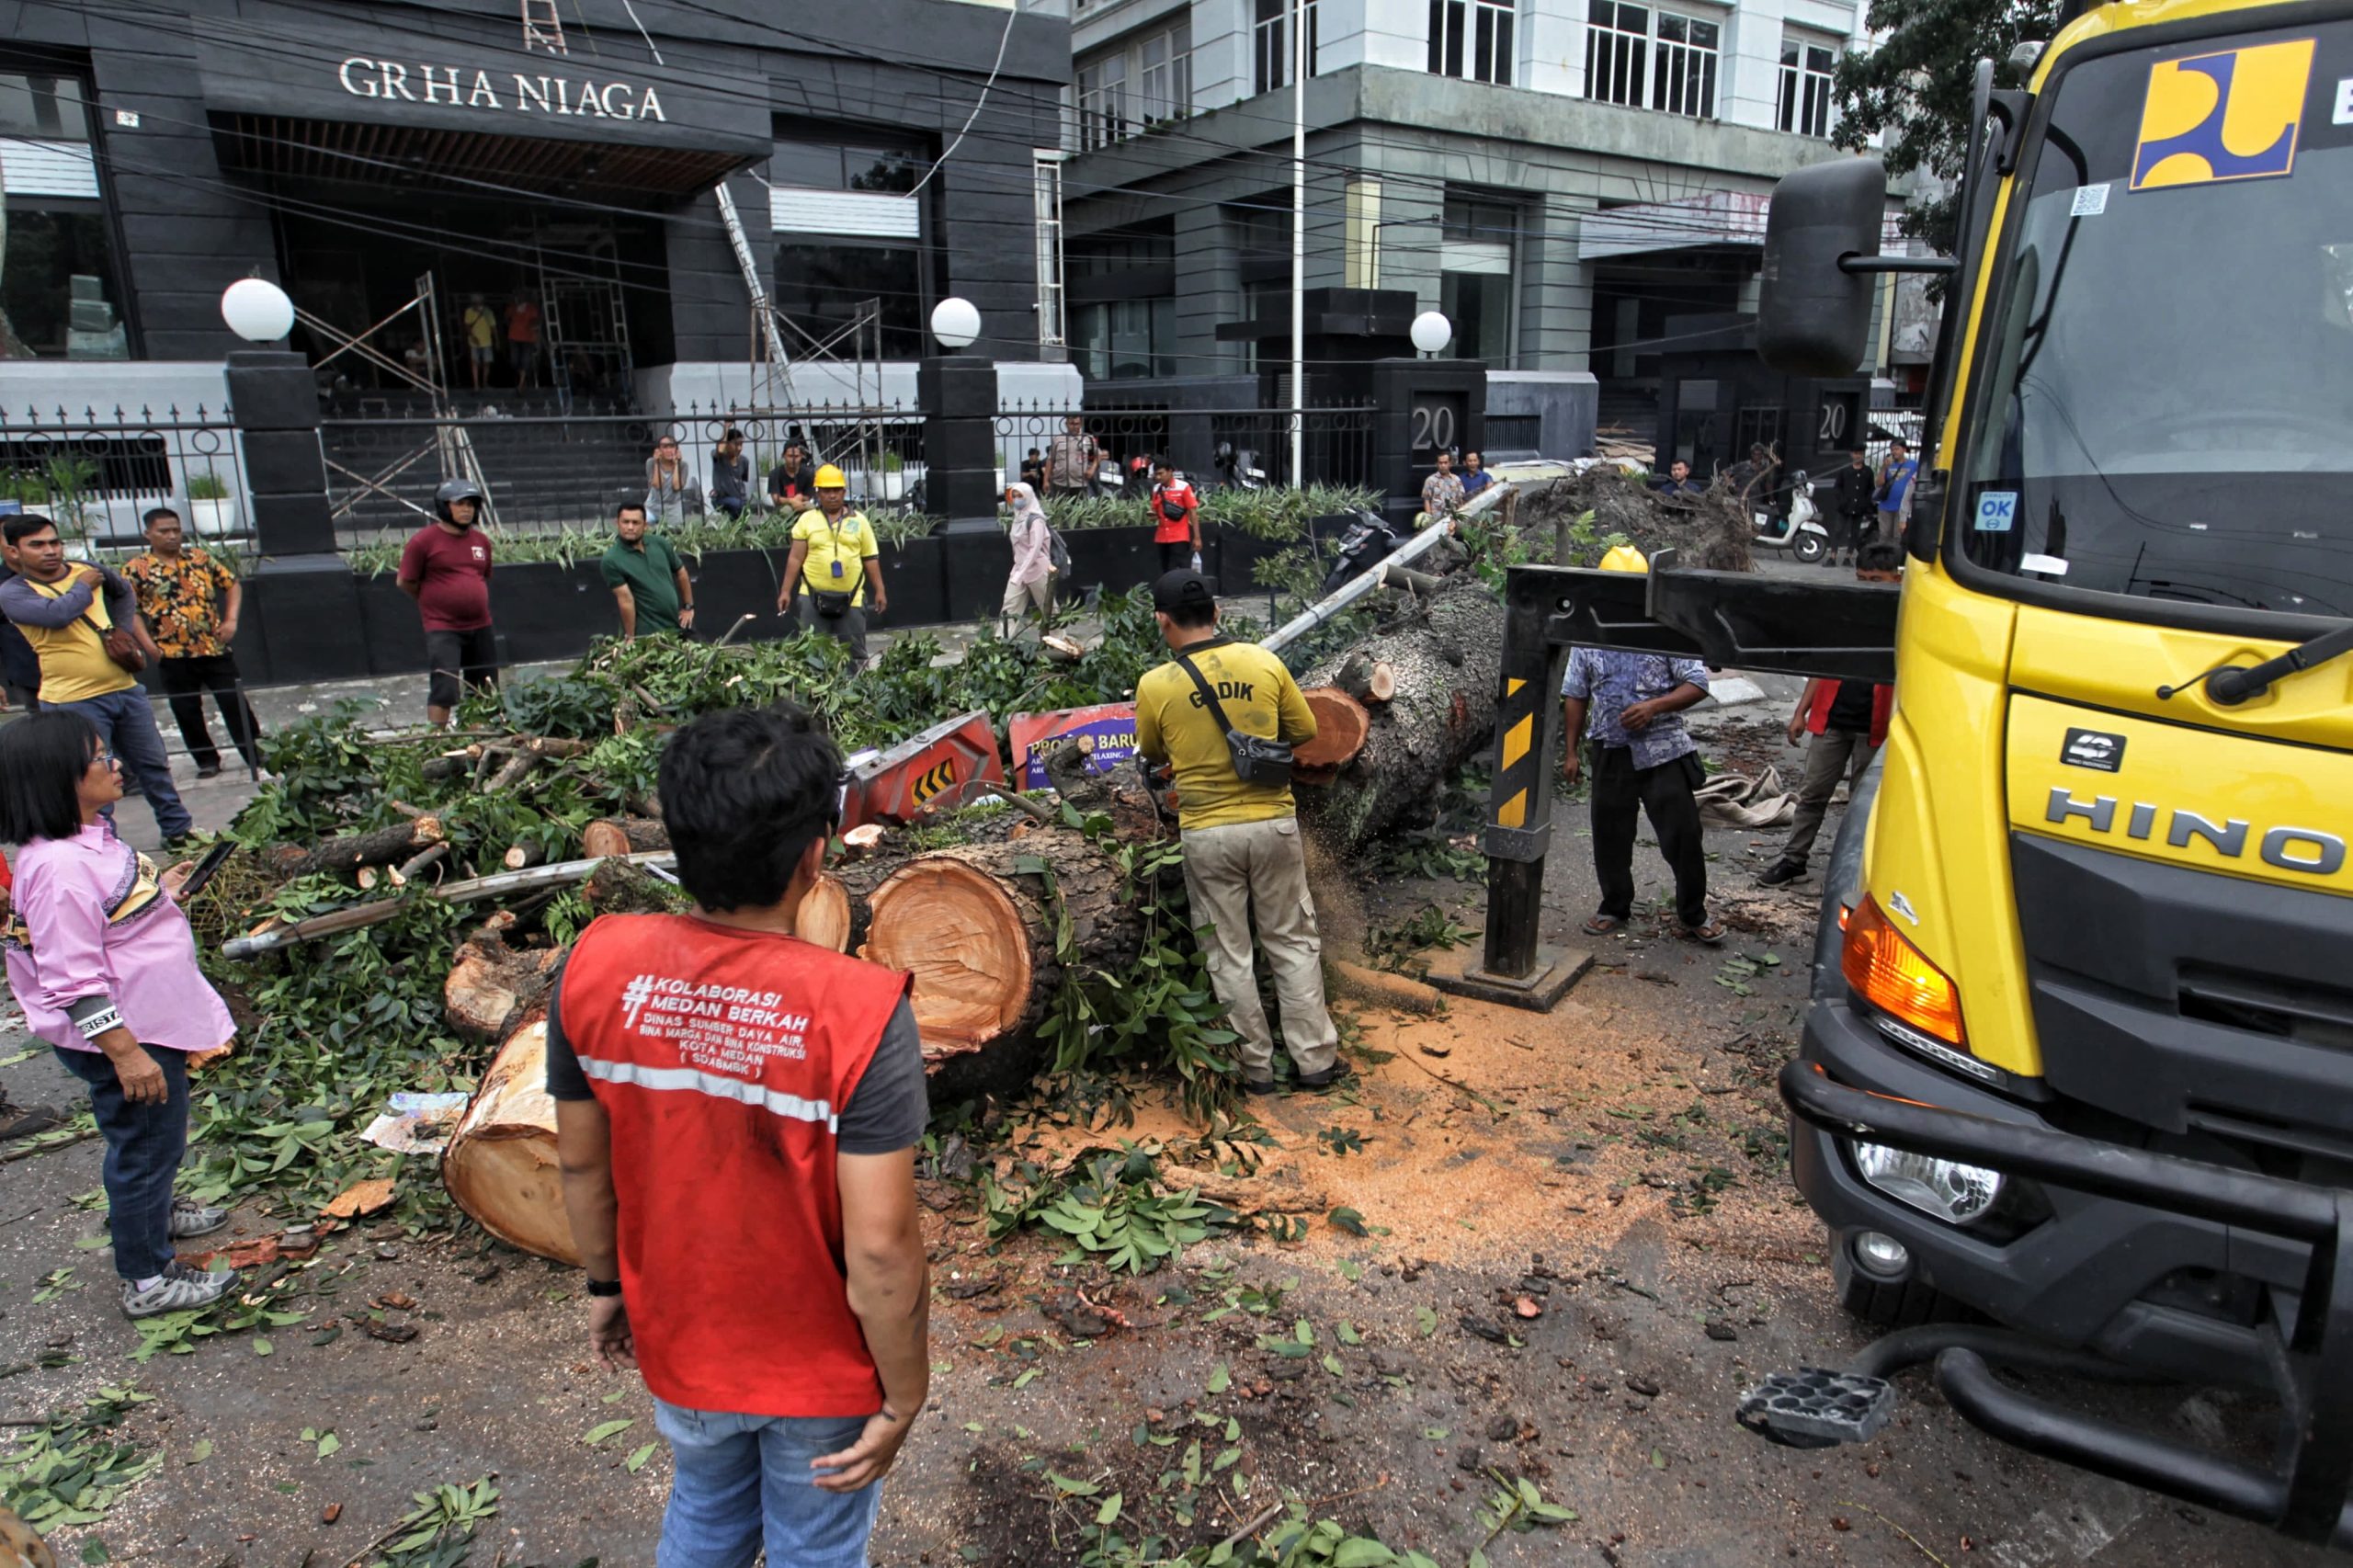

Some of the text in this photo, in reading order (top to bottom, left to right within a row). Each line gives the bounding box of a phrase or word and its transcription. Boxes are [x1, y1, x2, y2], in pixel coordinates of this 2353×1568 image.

[339, 58, 666, 121] GRHA NIAGA
[1413, 407, 1454, 449] 20
[1820, 404, 1846, 439] 20
[1982, 501, 2011, 517] OK
[1092, 752, 1124, 761] ELAXING
[2046, 787, 2346, 874] HINO
[643, 1013, 804, 1049] DINAS SUMBER DAYA AIR,
[651, 994, 808, 1032] MEDAN BERKAH
[640, 1024, 662, 1037] BINA
[665, 1028, 701, 1040] MARGA
[724, 1037, 744, 1051] BINA
[746, 1040, 806, 1060] KONSTRUKSI
[679, 1040, 765, 1066] KOTA MEDAN
